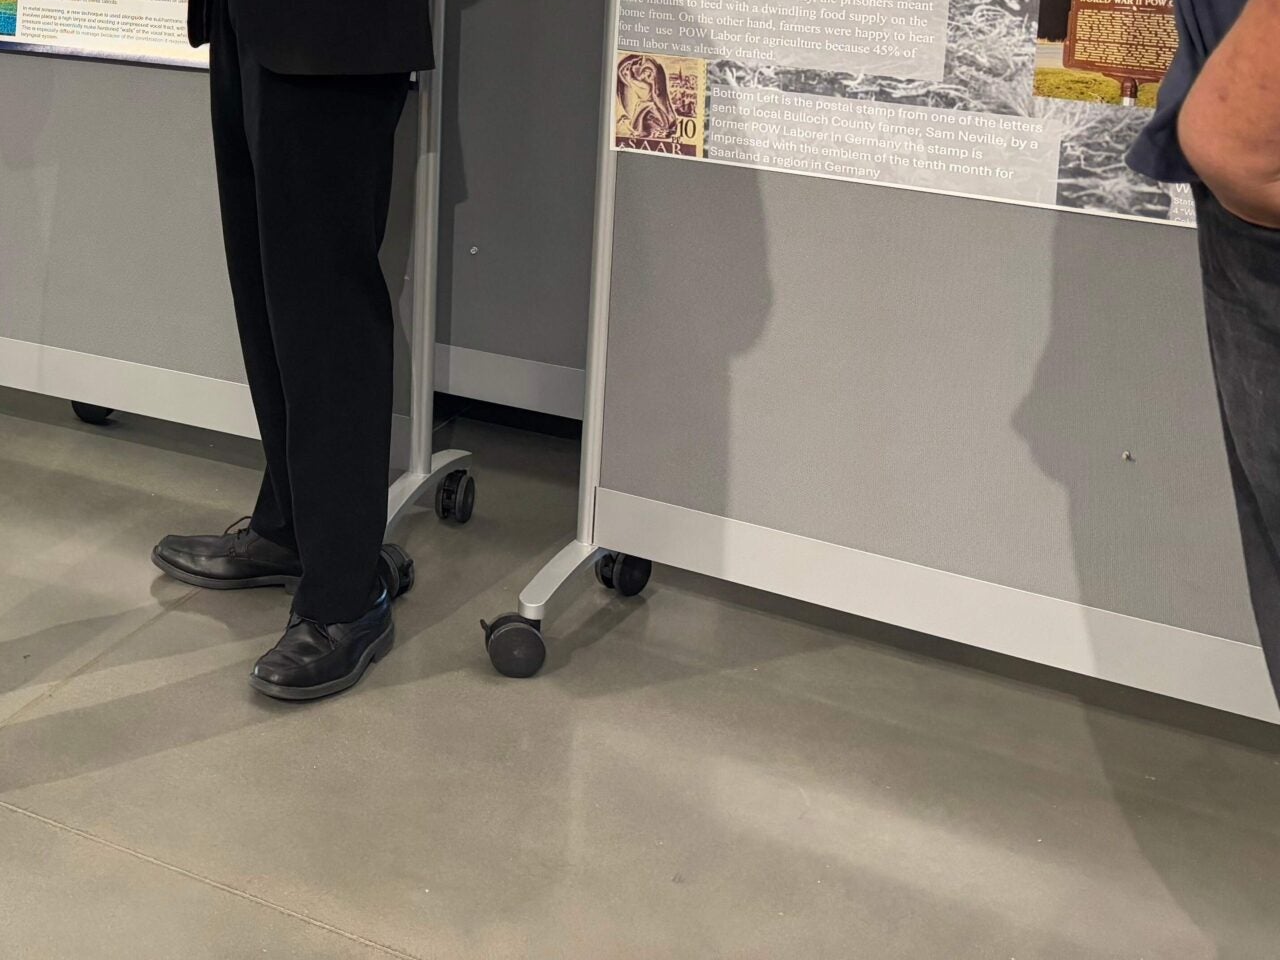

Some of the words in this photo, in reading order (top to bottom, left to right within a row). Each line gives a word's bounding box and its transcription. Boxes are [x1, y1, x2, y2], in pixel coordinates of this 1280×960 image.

[713, 88, 754, 102] Bottom
[757, 93, 779, 104] Left
[782, 96, 792, 105] is
[794, 97, 813, 108] the
[816, 101, 853, 113] postal
[856, 105, 895, 118] stamp
[898, 108, 927, 121] from
[932, 114, 955, 123] one
[959, 115, 972, 126] of
[975, 117, 996, 128] the
[999, 119, 1043, 133] letters
[678, 120, 696, 139] 10
[711, 146, 760, 162] Saarland
[762, 155, 769, 163] a
[773, 156, 808, 170] region
[811, 160, 821, 169] in
[825, 160, 880, 179] Germany
